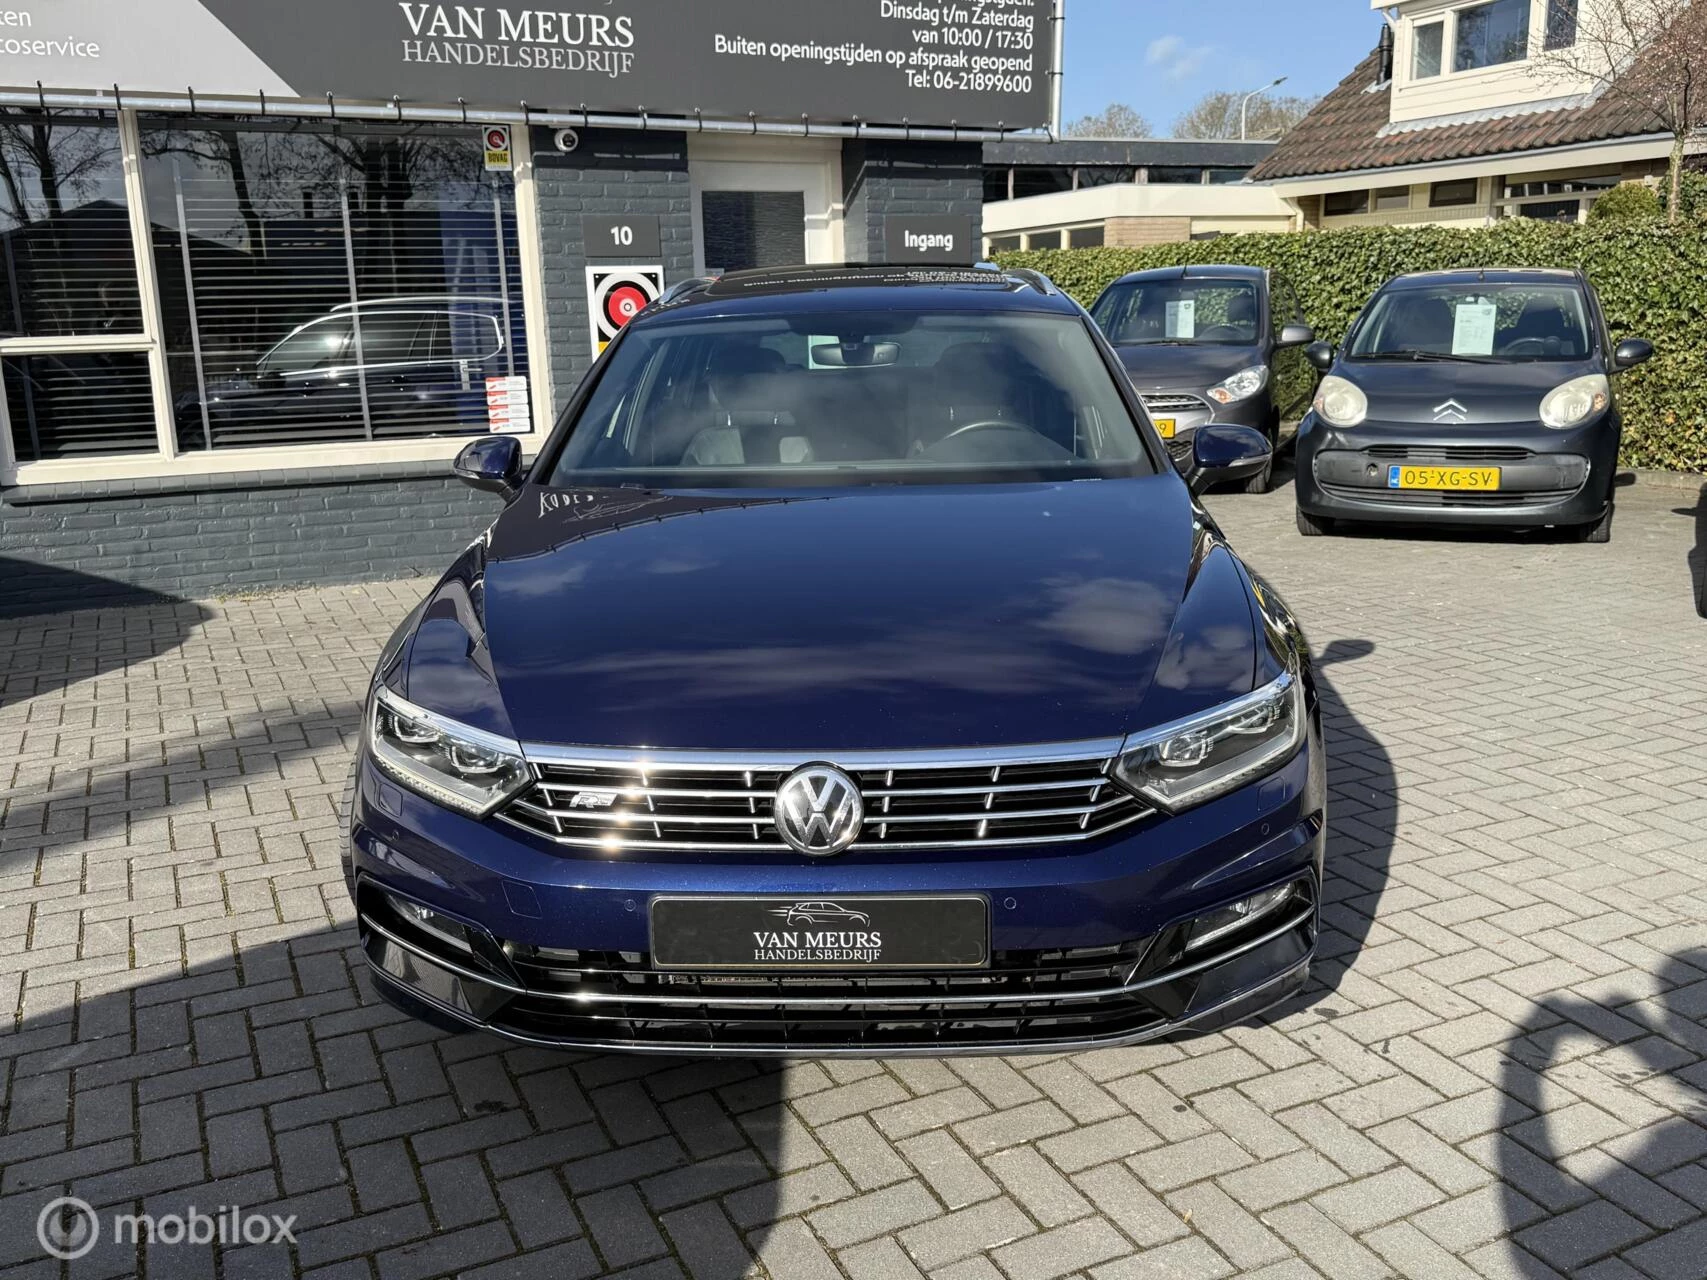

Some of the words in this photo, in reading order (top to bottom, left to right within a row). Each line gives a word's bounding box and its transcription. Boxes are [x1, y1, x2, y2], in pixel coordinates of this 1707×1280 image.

[399, 2, 485, 39] VAN
[497, 8, 635, 47] MEURS
[880, 0, 939, 26] Dinsdag
[943, 4, 968, 24] t/m
[971, 7, 1034, 32] Zaterdag
[912, 29, 938, 45] van
[942, 28, 981, 47] 10:00
[985, 29, 992, 49] /
[995, 30, 1034, 50] 17:30
[402, 39, 635, 79] HANDELSBEDRIJF
[714, 34, 766, 56] Buiten
[769, 41, 882, 66] openingstijden
[885, 51, 905, 69] op
[908, 48, 968, 70] afspraak
[971, 55, 1033, 73] geopend
[905, 69, 931, 89] Tel:
[933, 71, 1032, 93] 06-21899600
[610, 225, 633, 246] 10
[904, 229, 954, 252] Ingang
[1404, 470, 1493, 486] 05-XG-SV
[753, 931, 799, 948] VAN
[804, 931, 882, 948] MEURS
[754, 949, 882, 963] HANDELSBEDRIJF
